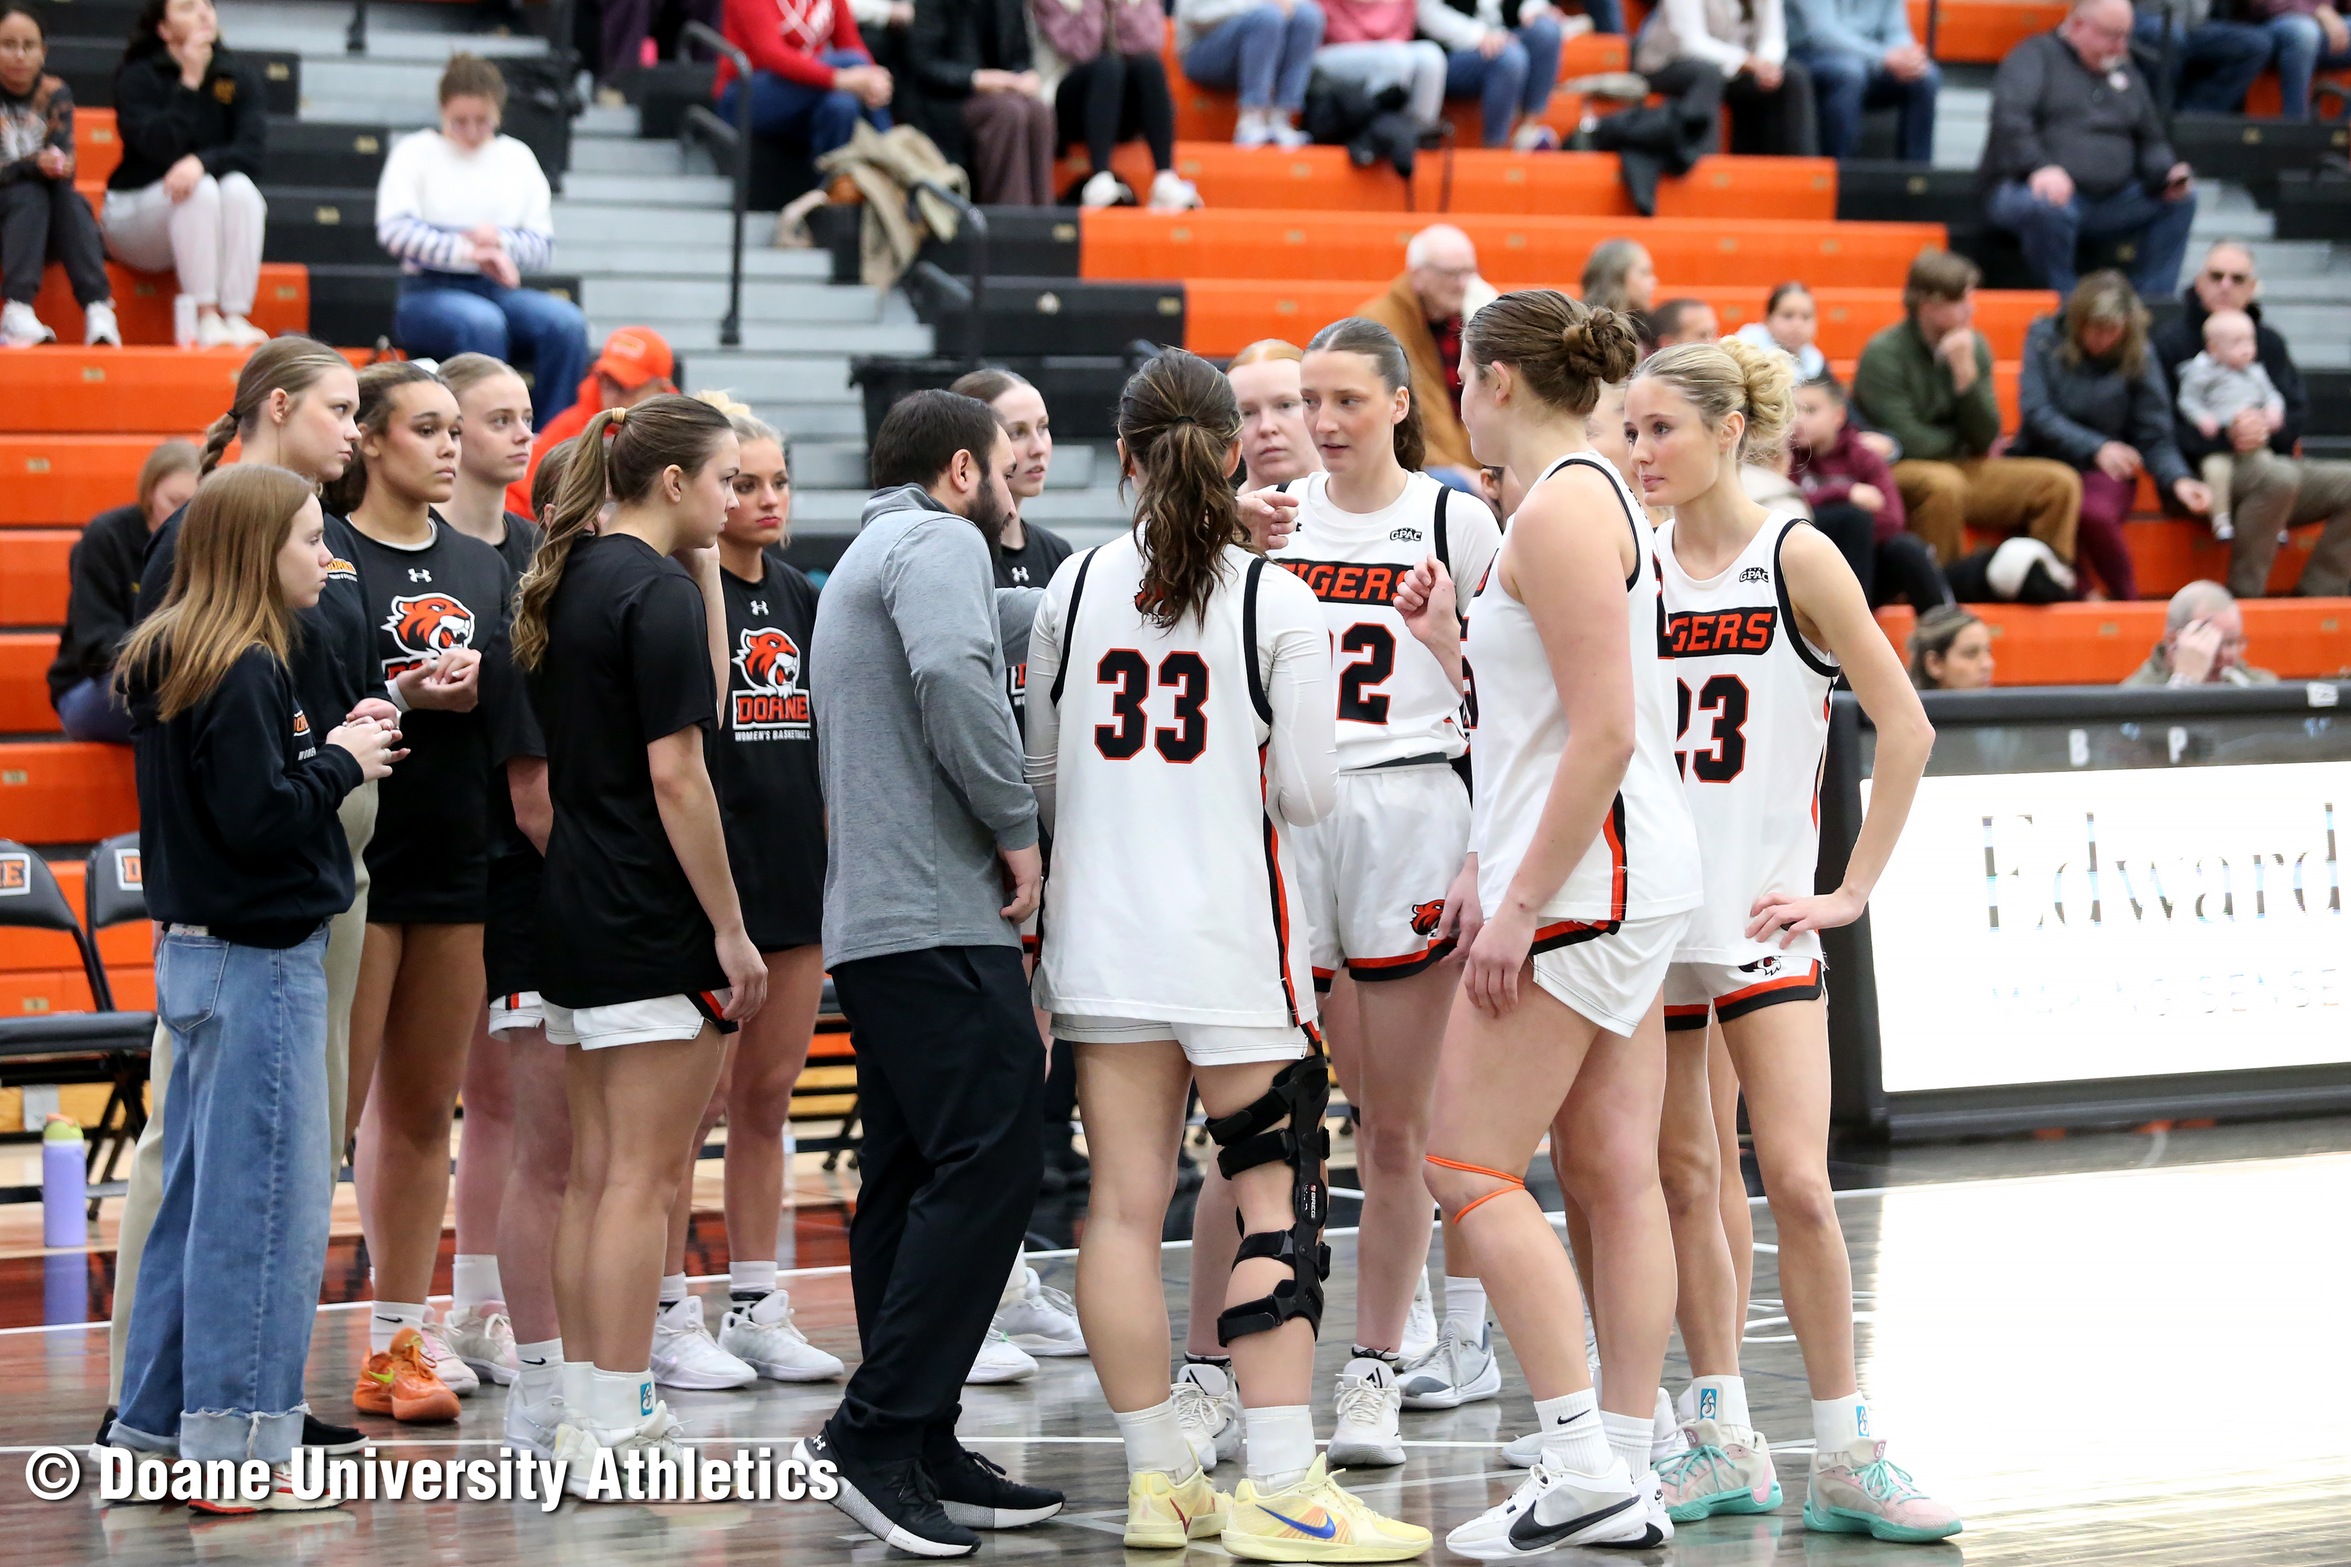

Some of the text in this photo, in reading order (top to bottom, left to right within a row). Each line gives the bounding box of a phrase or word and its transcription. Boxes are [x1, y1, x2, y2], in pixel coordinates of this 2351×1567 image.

[1390, 529, 1422, 541] GPAC
[1739, 569, 1769, 582] GPAC
[1670, 612, 1772, 652] GERS
[1328, 621, 1397, 725] 2
[737, 696, 809, 722] DOANE
[1094, 648, 1209, 764] 33
[734, 729, 811, 742] WOMEN'S BASKETBALL
[1982, 802, 2341, 932] Edward
